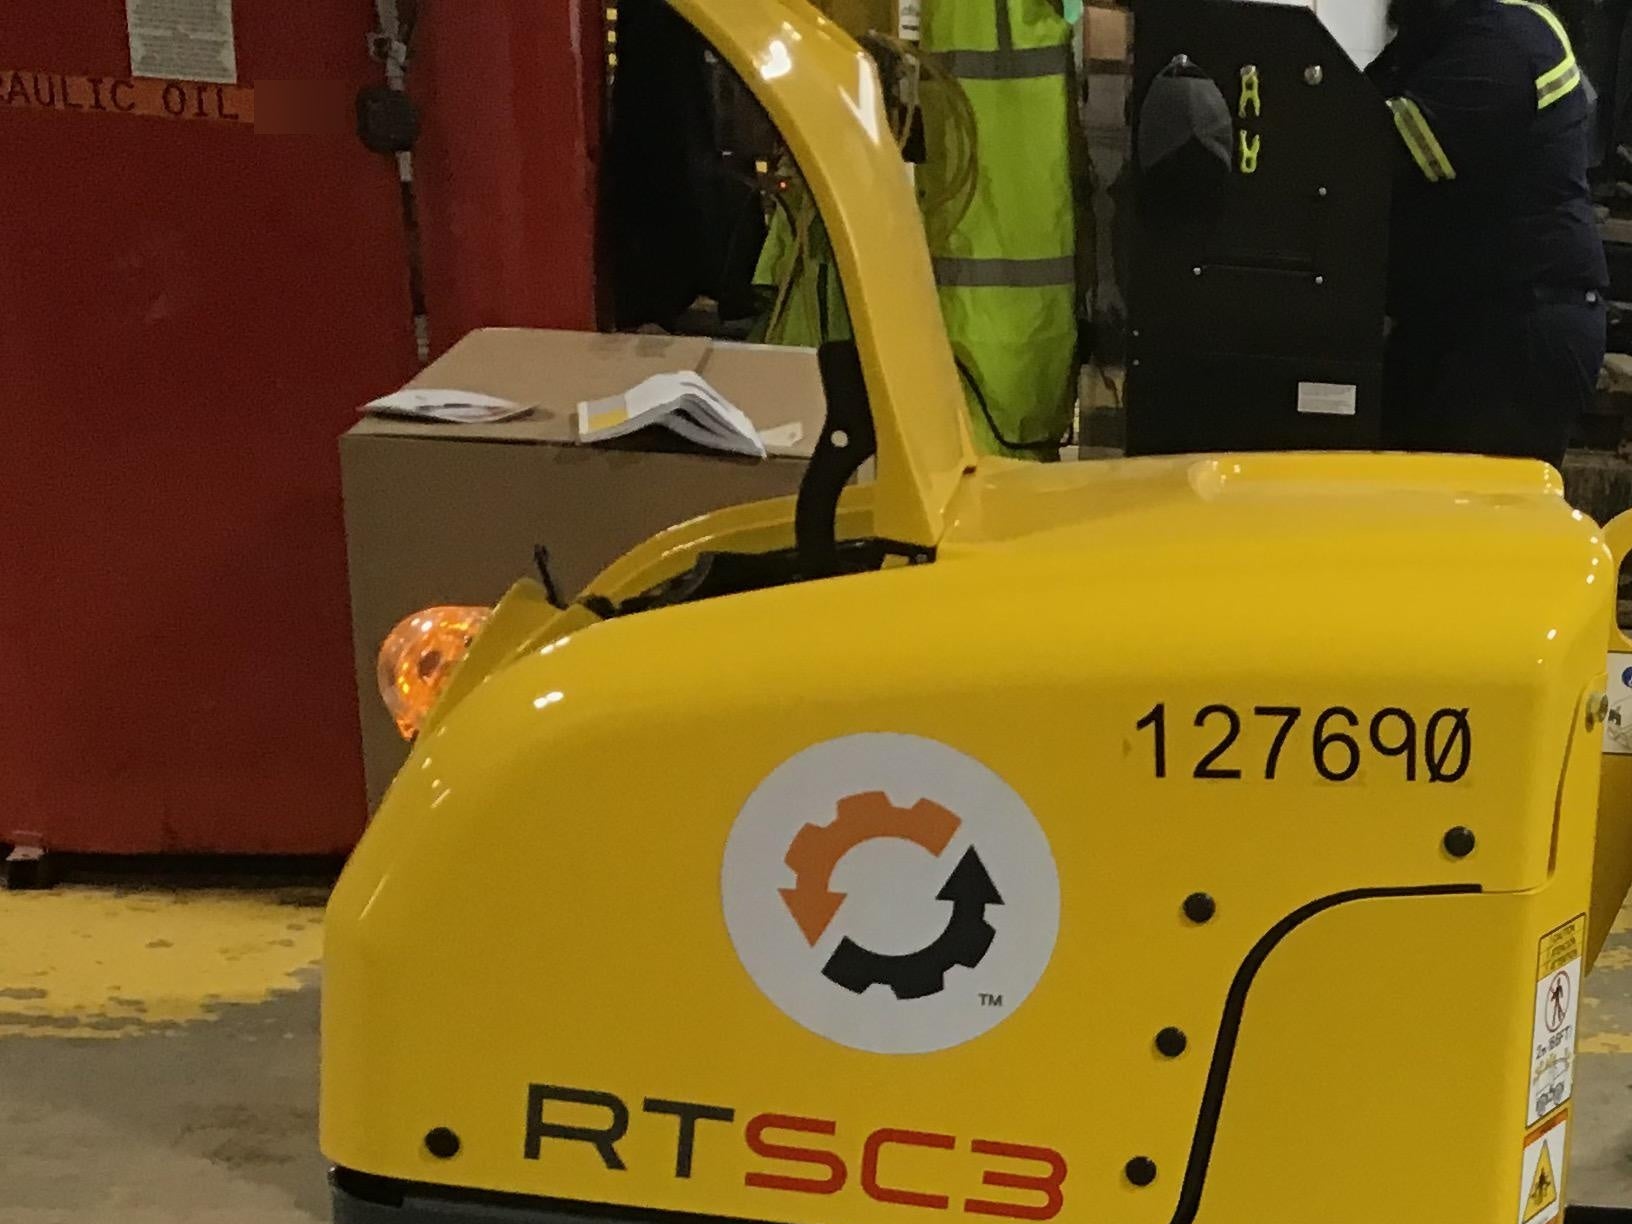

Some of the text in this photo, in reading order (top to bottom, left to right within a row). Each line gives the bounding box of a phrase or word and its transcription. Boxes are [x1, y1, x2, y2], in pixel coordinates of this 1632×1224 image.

[0, 71, 239, 120] AULIC OIL
[1136, 703, 1471, 783] 127690
[524, 1083, 1067, 1221] RTSC3
